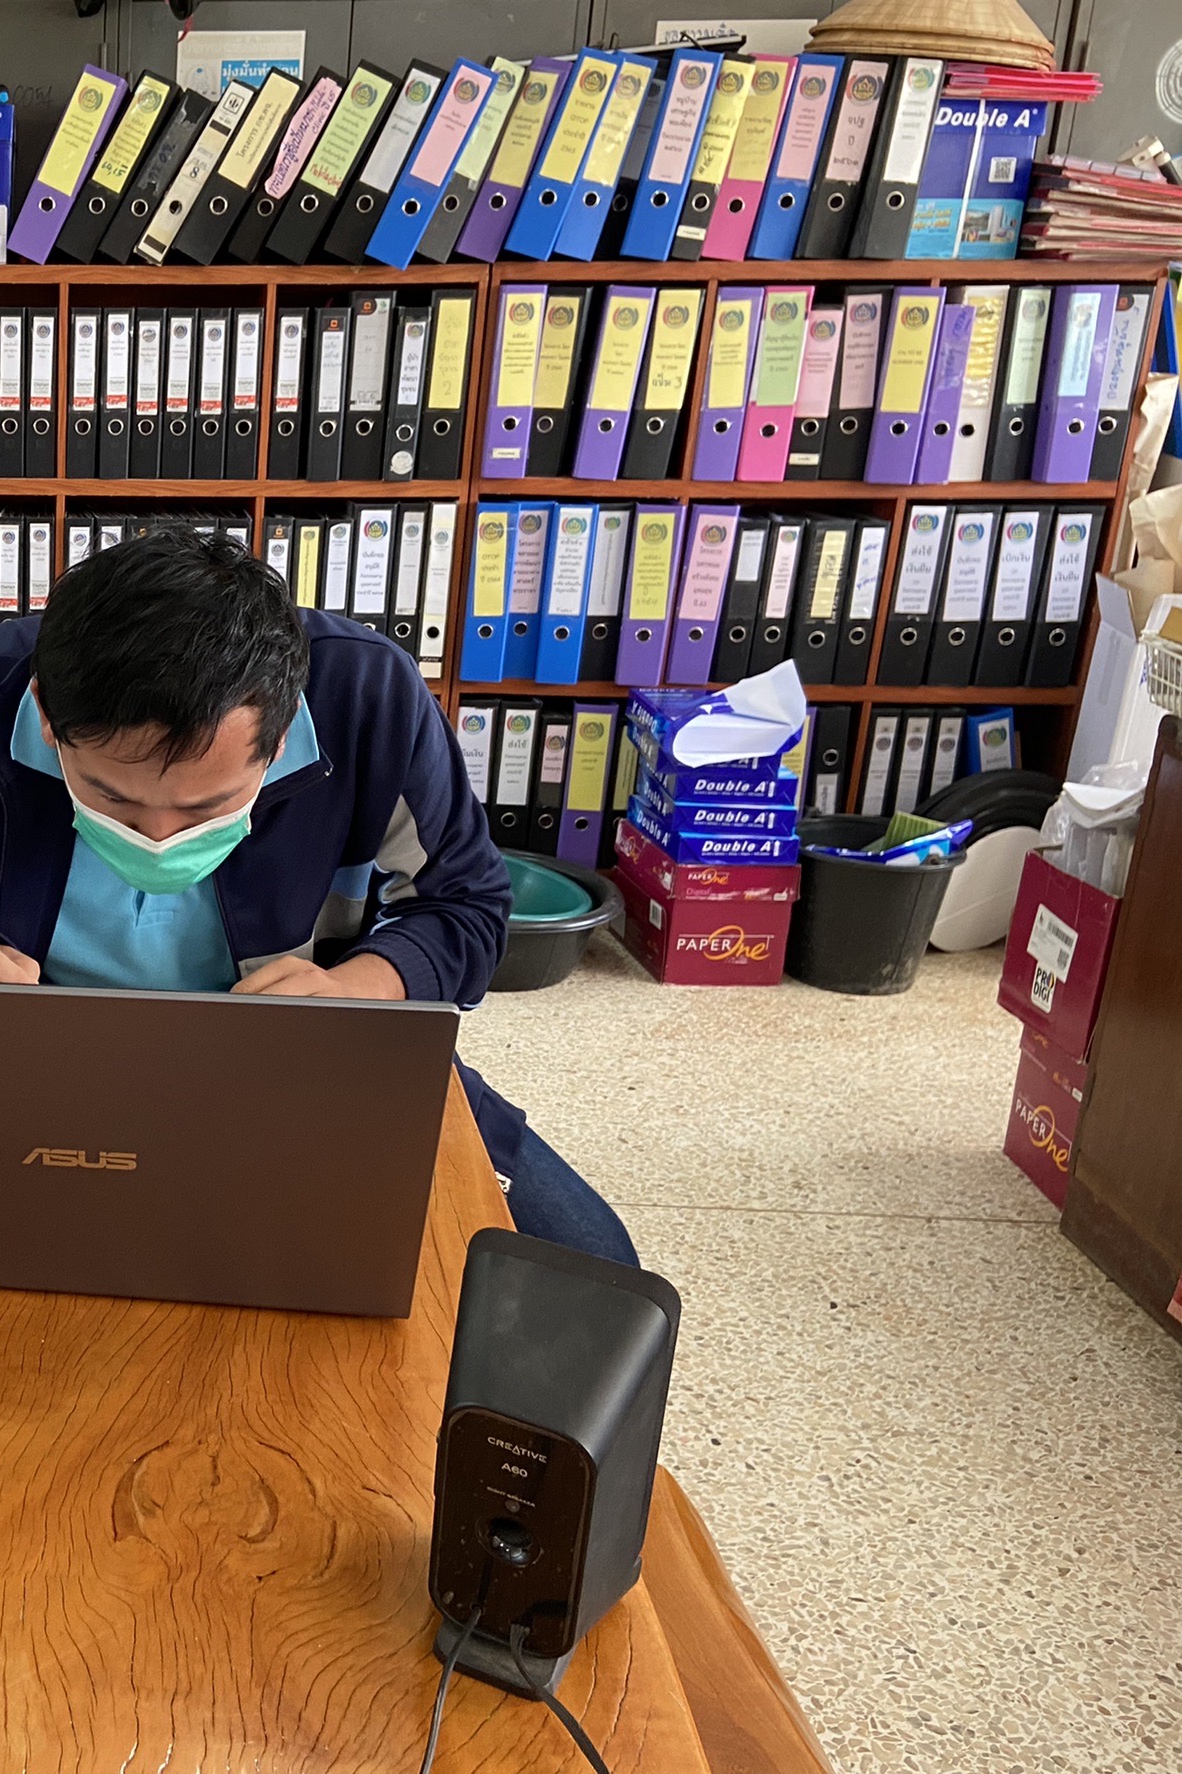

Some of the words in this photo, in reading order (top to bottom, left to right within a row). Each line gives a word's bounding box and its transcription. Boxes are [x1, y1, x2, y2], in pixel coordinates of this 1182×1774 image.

[570, 114, 589, 123] OTOP
[934, 106, 1008, 127] Double
[1013, 109, 1031, 128] A
[443, 380, 452, 396] 2
[911, 546, 932, 557] ส่งใช้
[1002, 553, 1031, 564] เบิกเงิน
[1059, 553, 1080, 564] ส่งใช้
[905, 564, 932, 574] เงินยืม
[1054, 572, 1080, 582] เงินยืม
[508, 739, 528, 749] ส่งใช้
[694, 779, 750, 793] Double
[754, 781, 766, 793] A
[694, 810, 750, 823] Double
[754, 812, 766, 824] A
[636, 809, 662, 840] Double
[661, 833, 671, 848] A
[701, 840, 756, 853] Double
[760, 841, 771, 853] A
[21, 1147, 137, 1171] ASUS
[487, 1436, 547, 1463] CREATIVE
[501, 1462, 528, 1477] A60
